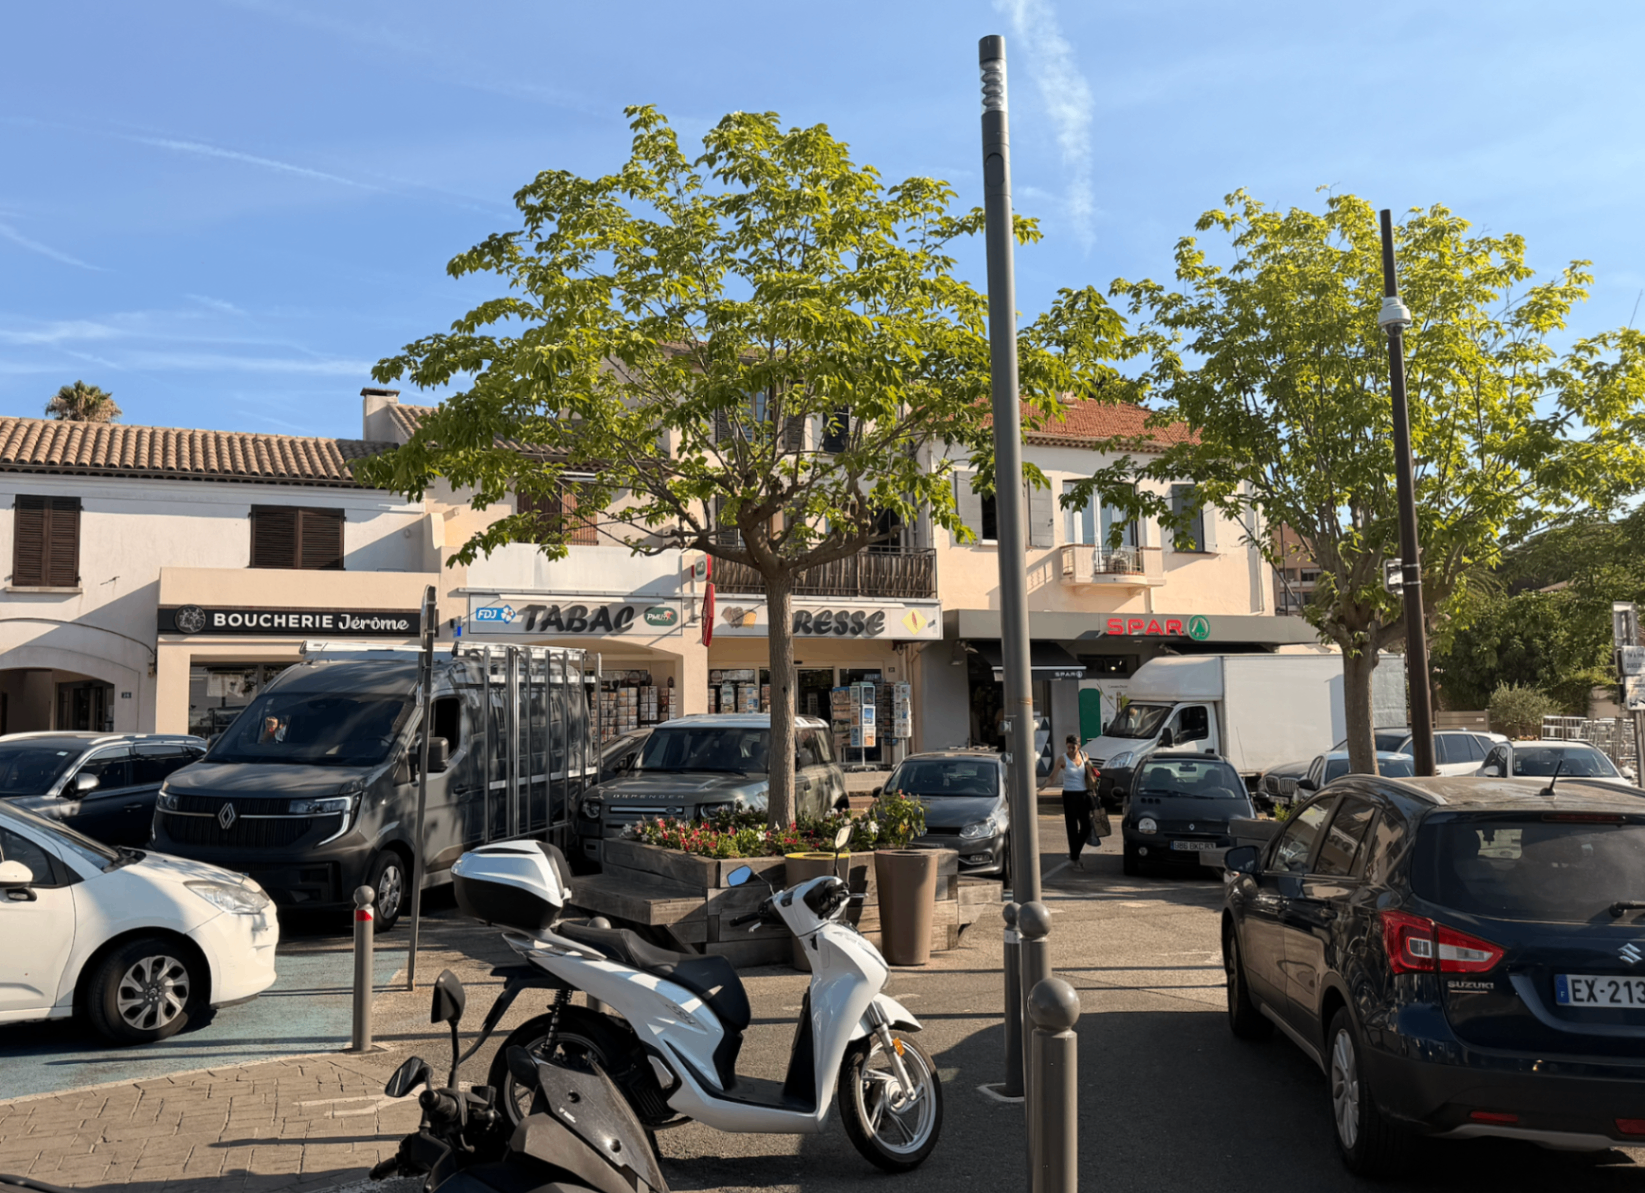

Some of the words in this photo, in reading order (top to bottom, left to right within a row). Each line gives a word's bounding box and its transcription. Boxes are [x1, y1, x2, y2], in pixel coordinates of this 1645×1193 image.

[213, 613, 333, 628] BOUCHERIE
[338, 613, 409, 631] Jérôme
[477, 609, 497, 619] FDJ
[524, 604, 635, 633] TABAC
[792, 609, 886, 637] RESSE
[1107, 618, 1183, 636] SPAR
[1447, 980, 1495, 989] SUZUKI
[1571, 978, 1645, 1004] EX-213
